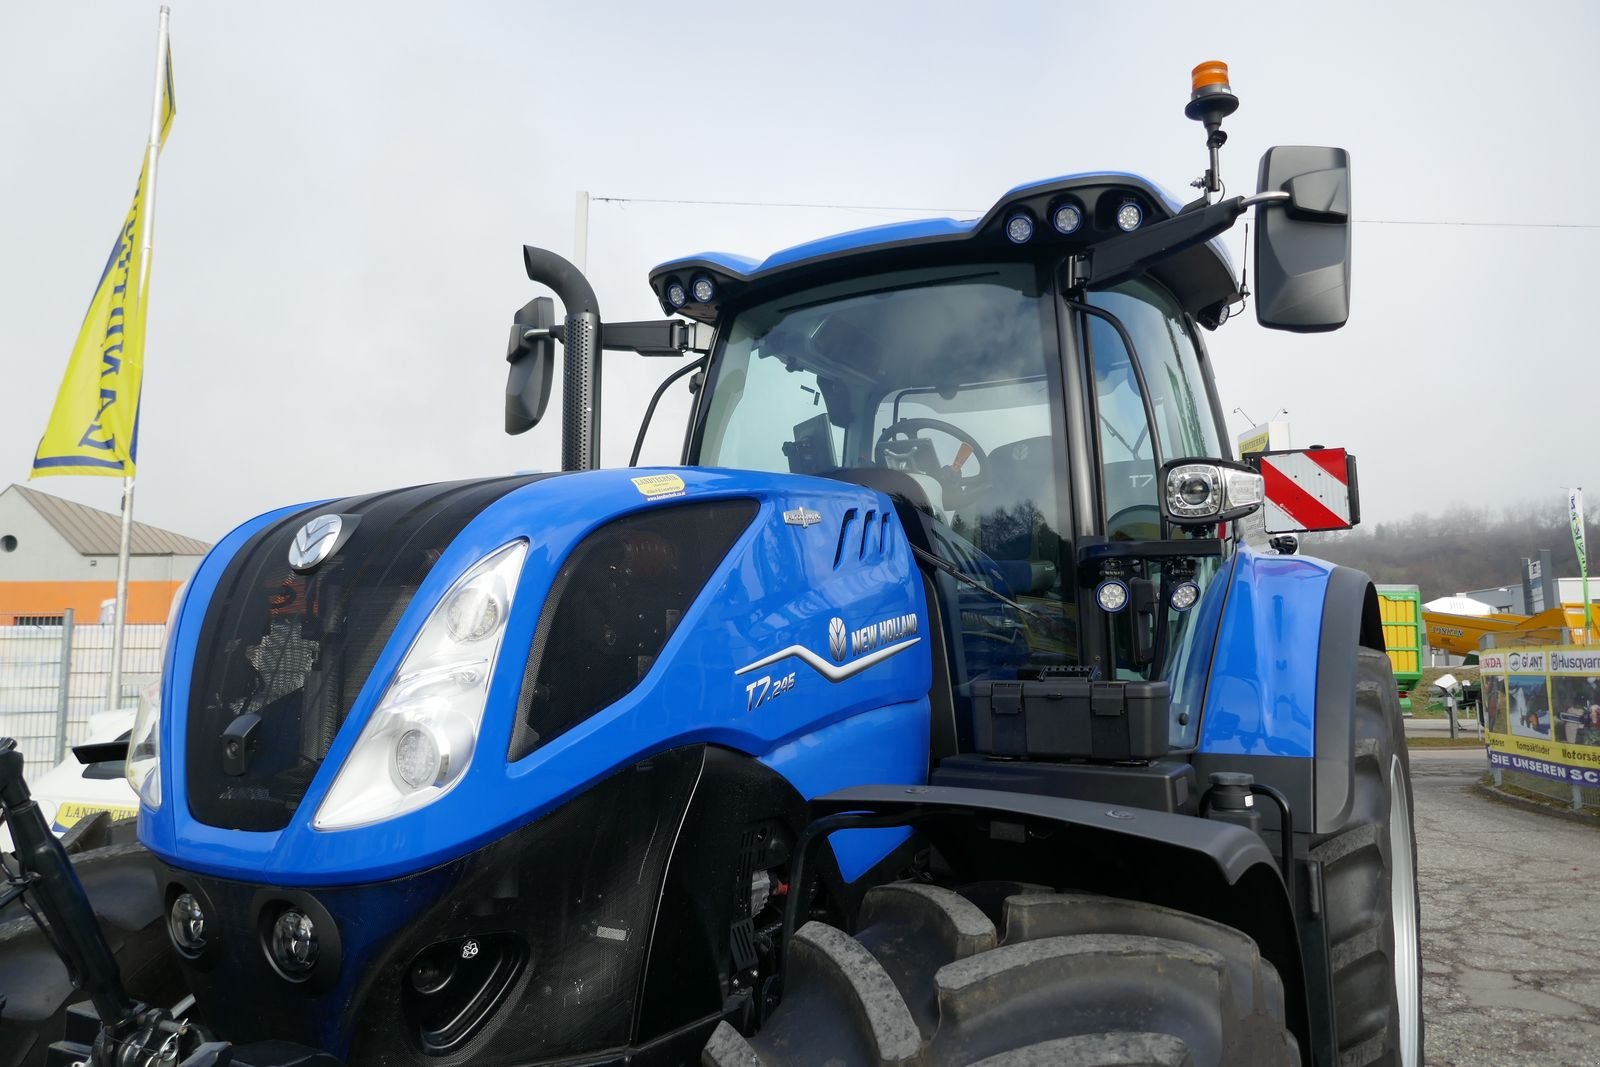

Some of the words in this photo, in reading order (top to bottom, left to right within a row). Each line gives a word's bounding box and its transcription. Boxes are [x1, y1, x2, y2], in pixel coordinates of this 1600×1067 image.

[1129, 474, 1154, 488] T7
[851, 623, 878, 656] NEW
[879, 613, 918, 645] HOLLAND
[746, 672, 796, 712] T7.245
[1491, 753, 1510, 766] SIE
[1512, 757, 1566, 778] UNSEREN
